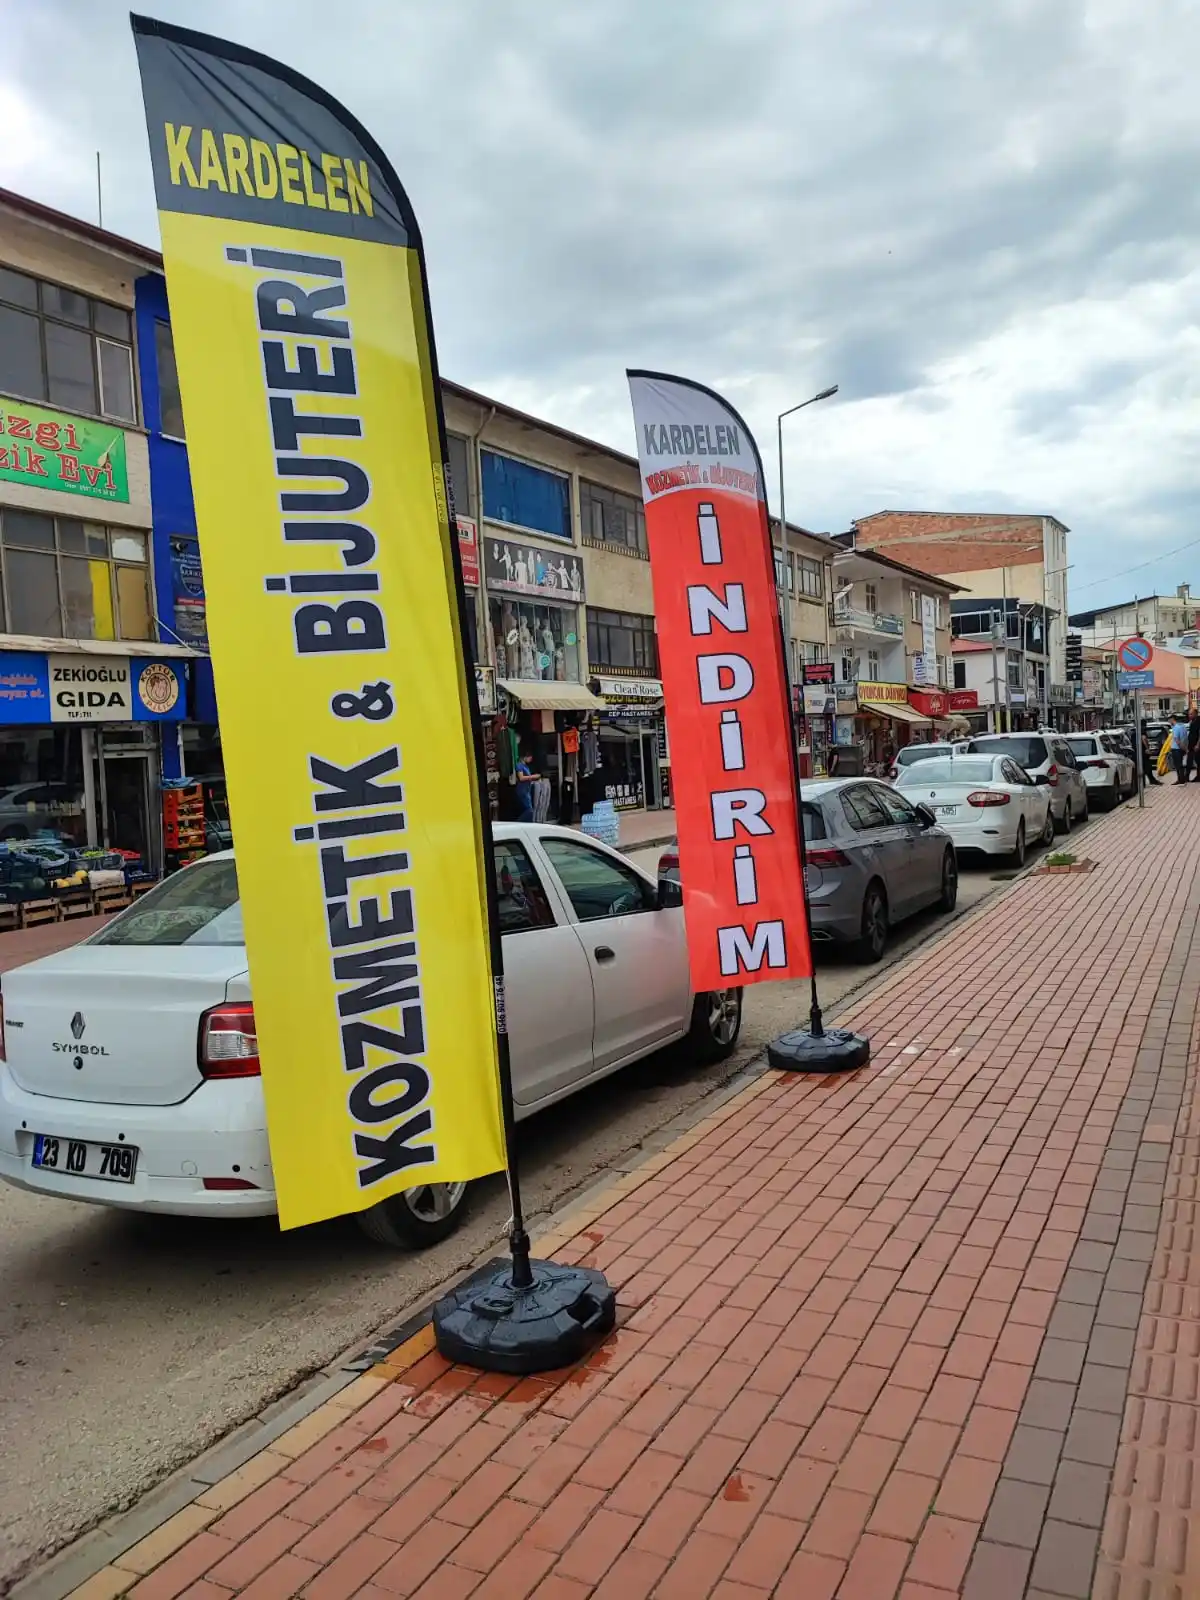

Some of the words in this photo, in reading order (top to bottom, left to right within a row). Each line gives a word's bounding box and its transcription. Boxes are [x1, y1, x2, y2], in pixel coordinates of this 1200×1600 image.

[164, 122, 374, 217] KARDELEN
[225, 246, 387, 653] BİJUTERİ
[643, 424, 741, 456] KARDELEN
[56, 452, 117, 489] Evi
[53, 665, 127, 682] ZEKİOĞLU
[614, 683, 638, 694] Clean
[640, 685, 660, 695] Rose
[56, 691, 126, 708] GIDA
[331, 681, 395, 721] &
[686, 502, 788, 977] İNDİRİM
[293, 745, 436, 1188] KOZMETİK
[51, 1042, 110, 1056] SYMBOL
[43, 1139, 60, 1167] 23
[66, 1142, 87, 1172] KD
[100, 1147, 134, 1178] 709
